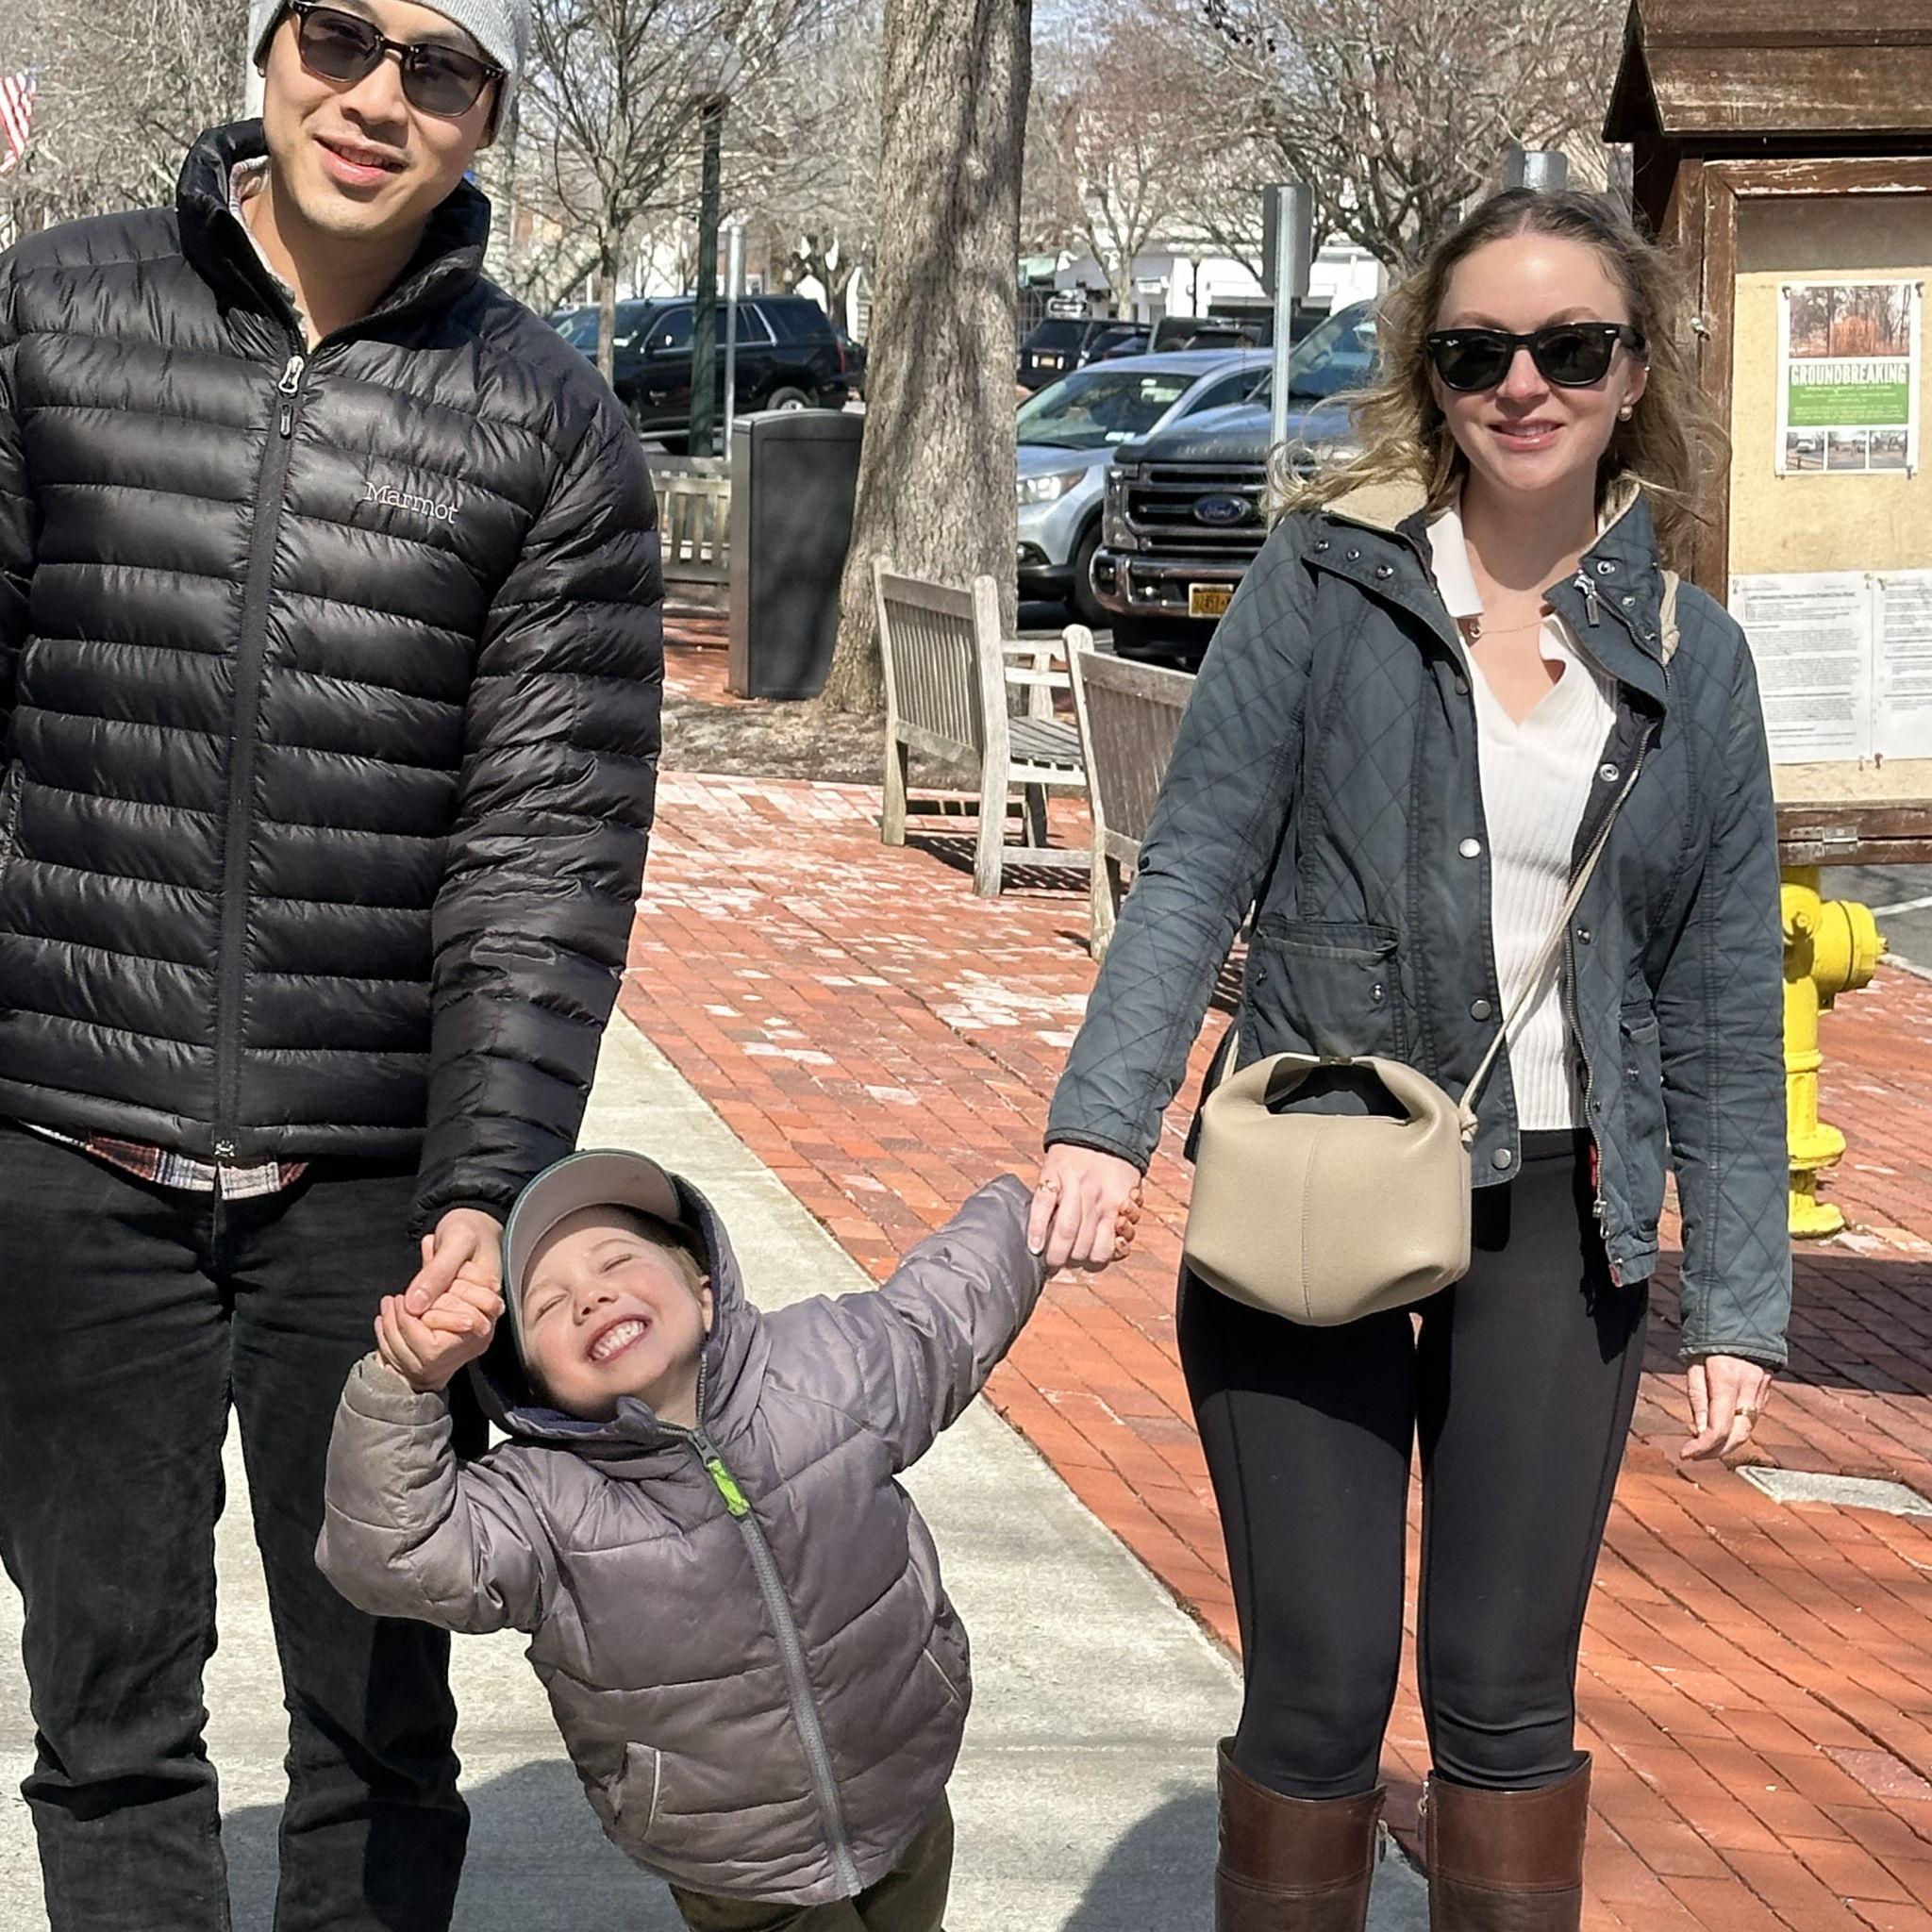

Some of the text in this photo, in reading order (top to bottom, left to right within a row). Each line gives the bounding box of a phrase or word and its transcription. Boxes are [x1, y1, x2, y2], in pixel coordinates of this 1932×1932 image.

[1790, 363, 1907, 385] GROUNDBREAKING
[362, 481, 458, 525] Marmot
[1204, 503, 1233, 518] Ford
